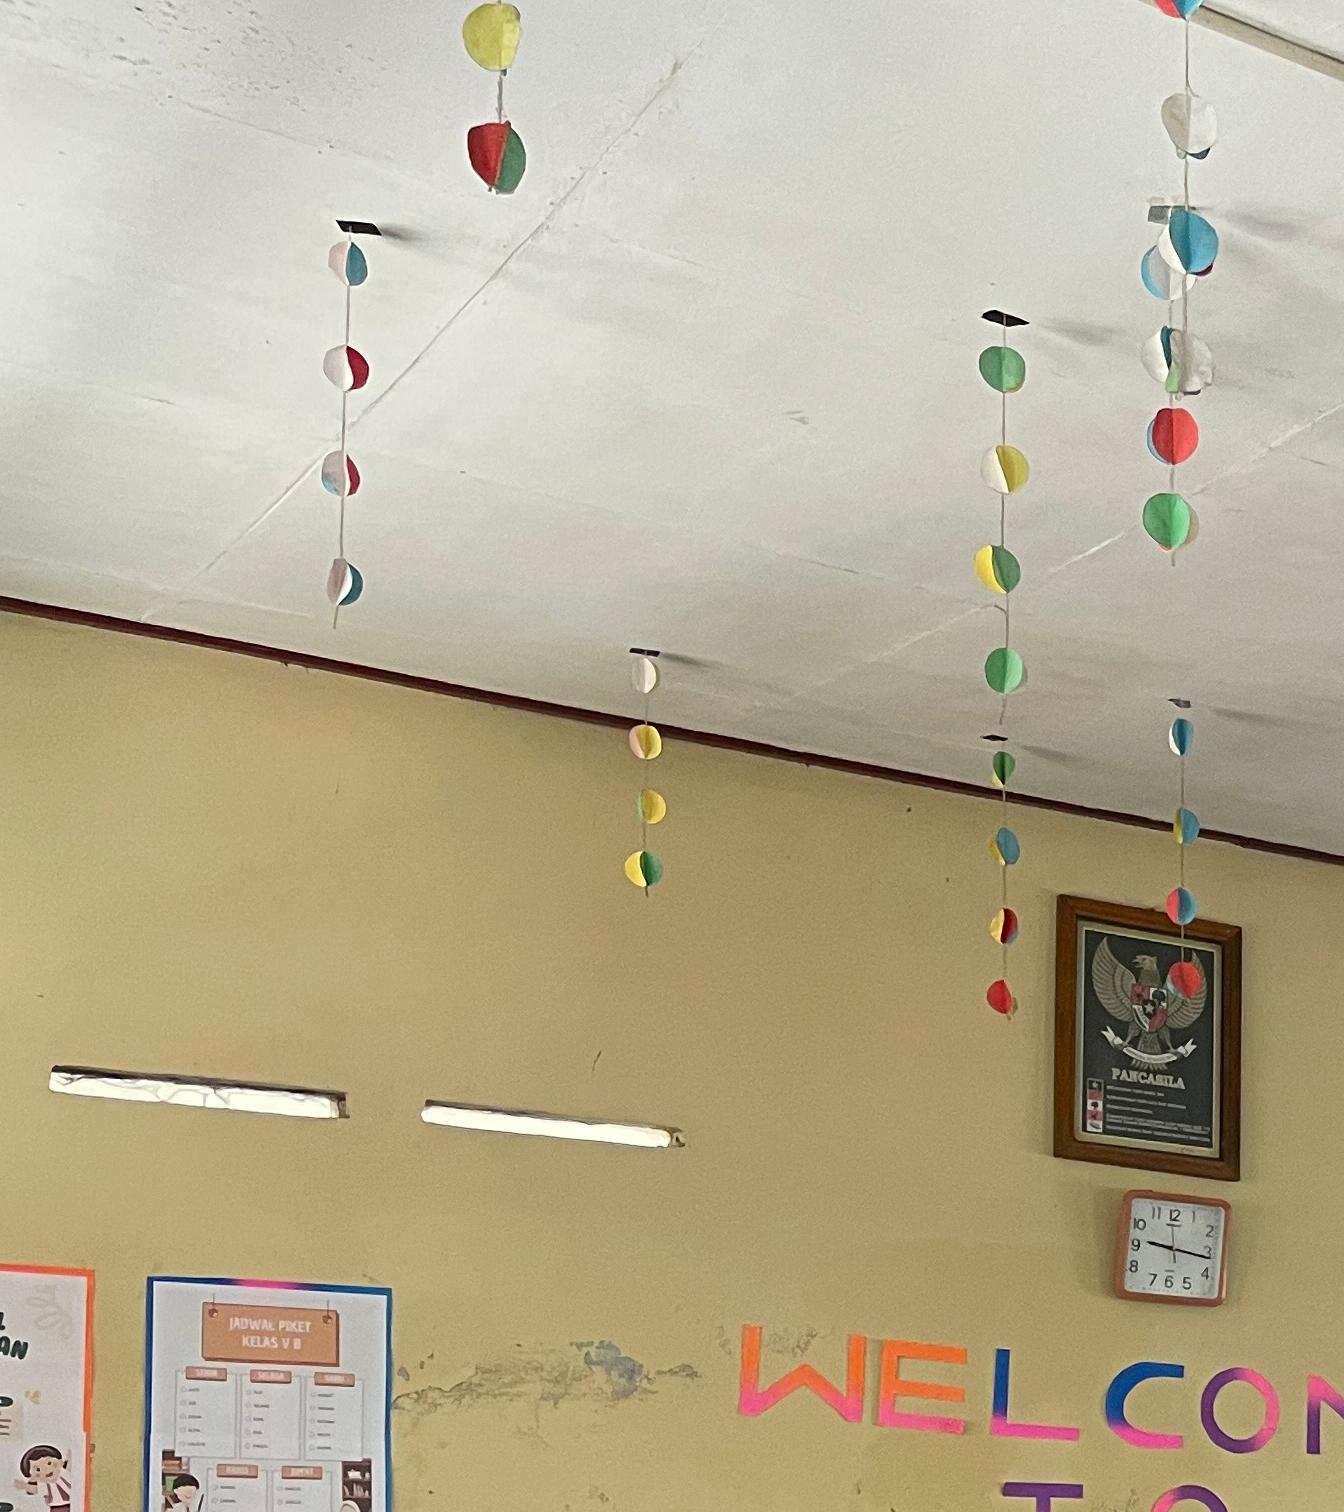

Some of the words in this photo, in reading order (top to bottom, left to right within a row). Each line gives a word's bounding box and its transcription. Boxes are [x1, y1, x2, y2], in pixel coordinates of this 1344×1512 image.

[1111, 1068, 1186, 1090] PANCASILA
[1152, 1207, 1161, 1220] 11
[1169, 1209, 1181, 1222] 12
[1192, 1211, 1196, 1223] 1
[1133, 1217, 1146, 1231] 10
[1205, 1225, 1215, 1237] 2
[1131, 1239, 1141, 1251] 9
[1129, 1260, 1138, 1273] 8
[1148, 1273, 1158, 1286] 7
[1201, 1267, 1209, 1280] 4
[1165, 1275, 1174, 1288] 6
[1182, 1277, 1192, 1290] 5
[228, 1317, 276, 1333] JADWAL
[278, 1319, 312, 1334] PIKET
[242, 1335, 279, 1350] KELAS
[282, 1337, 291, 1350] V
[292, 1338, 302, 1351] B
